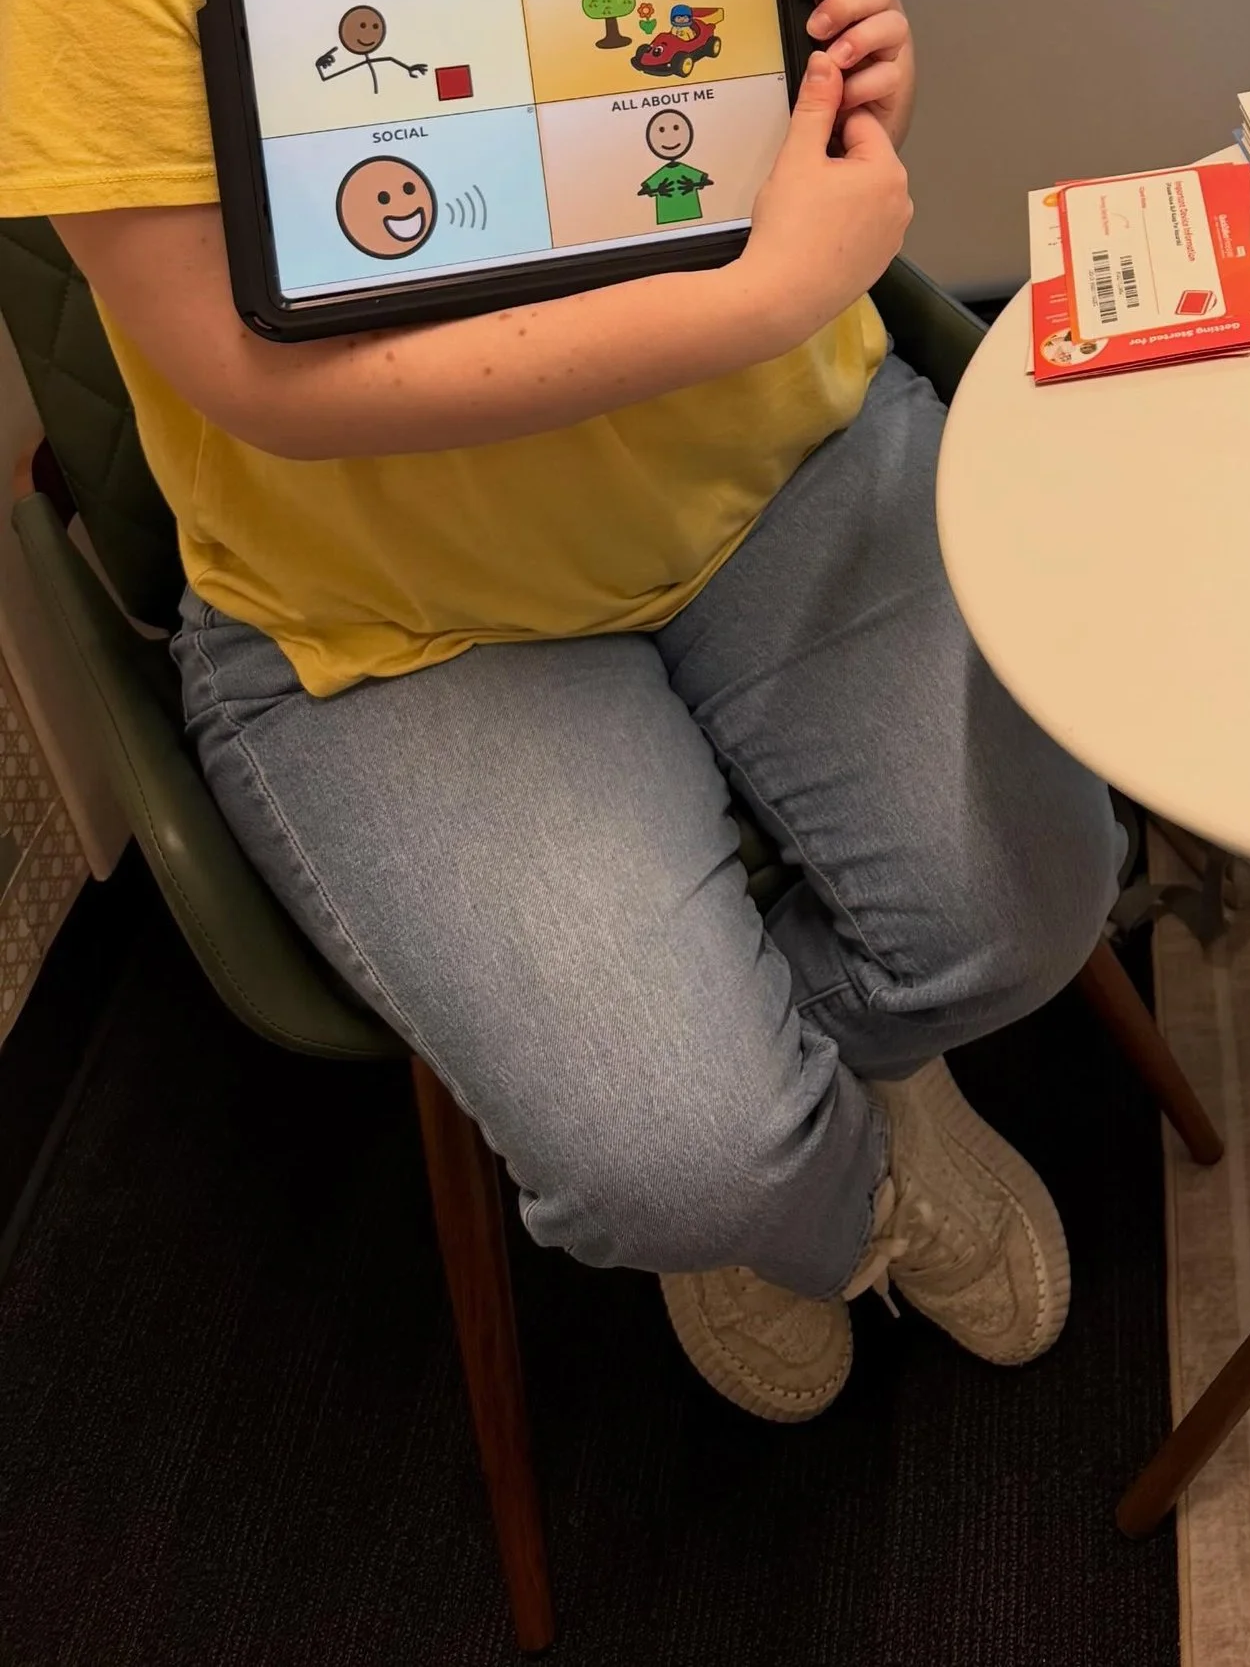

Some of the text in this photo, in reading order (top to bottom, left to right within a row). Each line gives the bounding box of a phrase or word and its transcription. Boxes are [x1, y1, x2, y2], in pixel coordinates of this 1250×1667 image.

[612, 89, 714, 112] ALL ABOUT ME
[372, 127, 428, 143] SOCIAL
[1173, 180, 1195, 261] Important Device Information
[1128, 321, 1240, 346] Getting Started for
